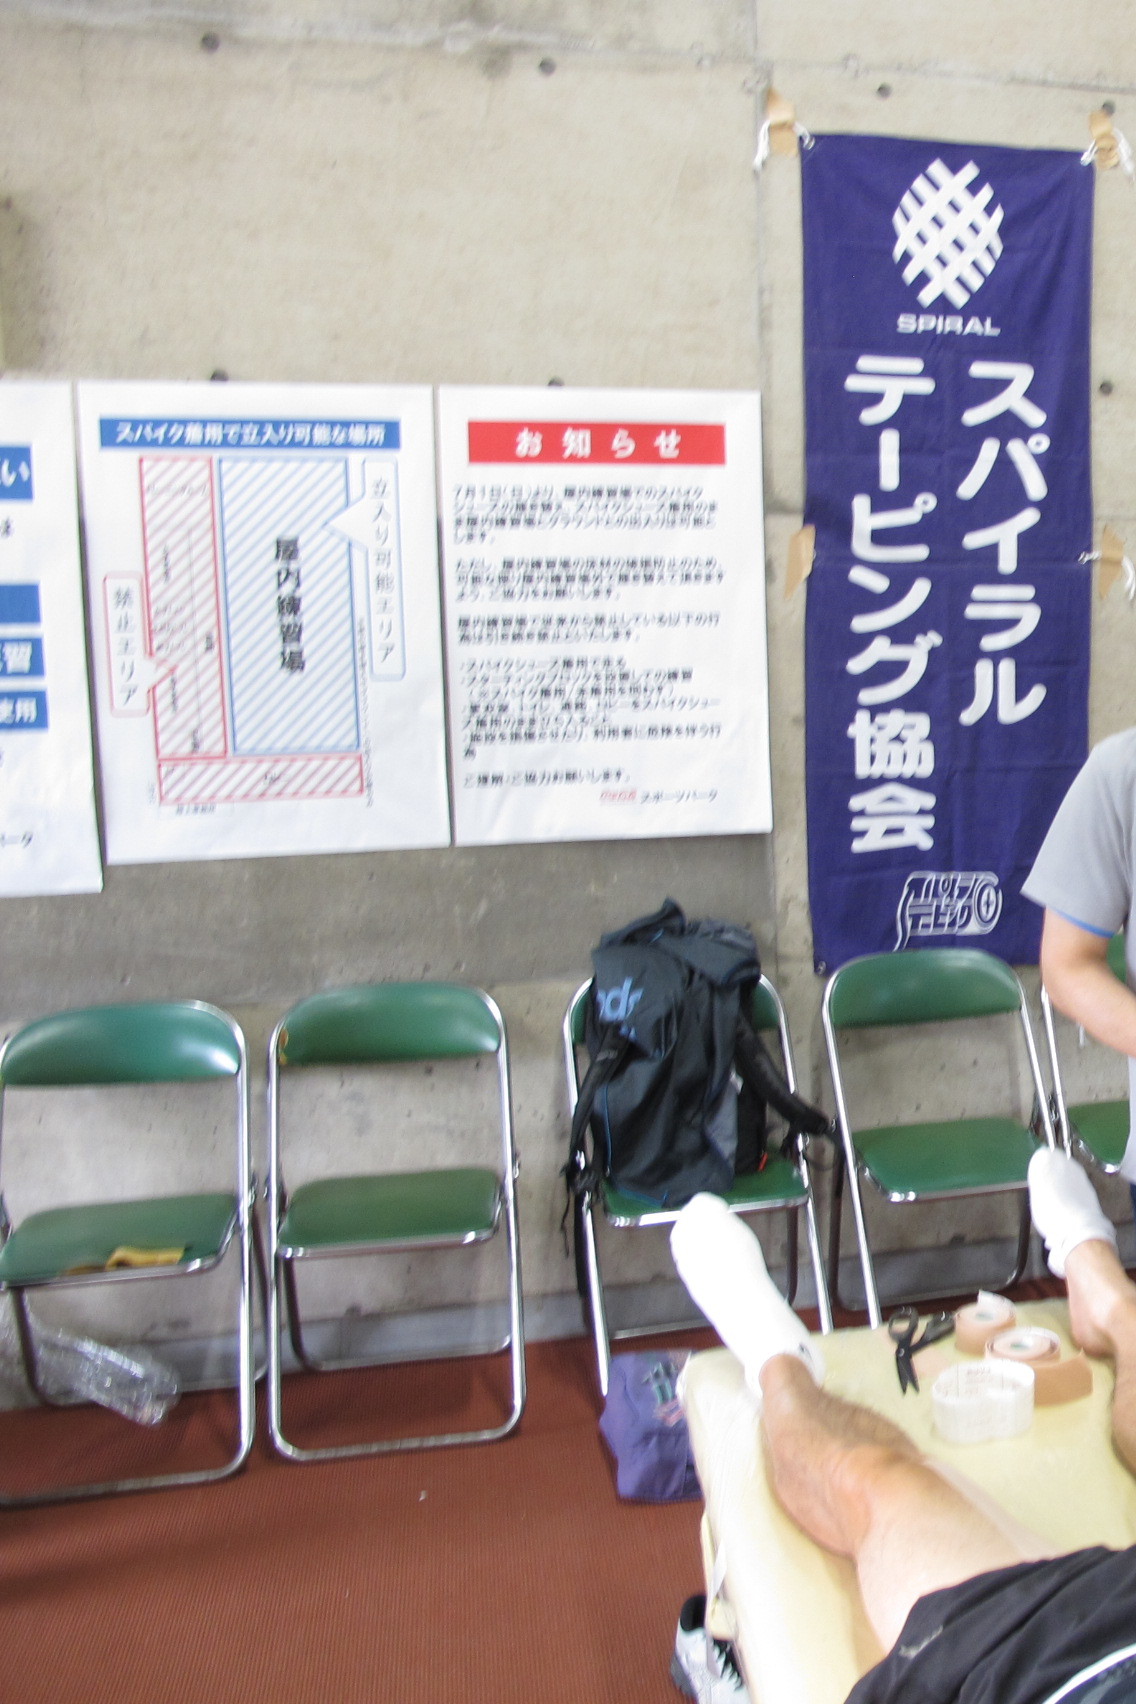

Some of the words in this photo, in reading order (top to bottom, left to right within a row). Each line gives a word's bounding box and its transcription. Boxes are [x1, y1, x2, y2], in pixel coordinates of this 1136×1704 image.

[897, 312, 1001, 336] SPIRAL
[515, 427, 681, 459] お知らせ
[956, 358, 1050, 727] スパイラル
[844, 355, 943, 854] テーピング協会
